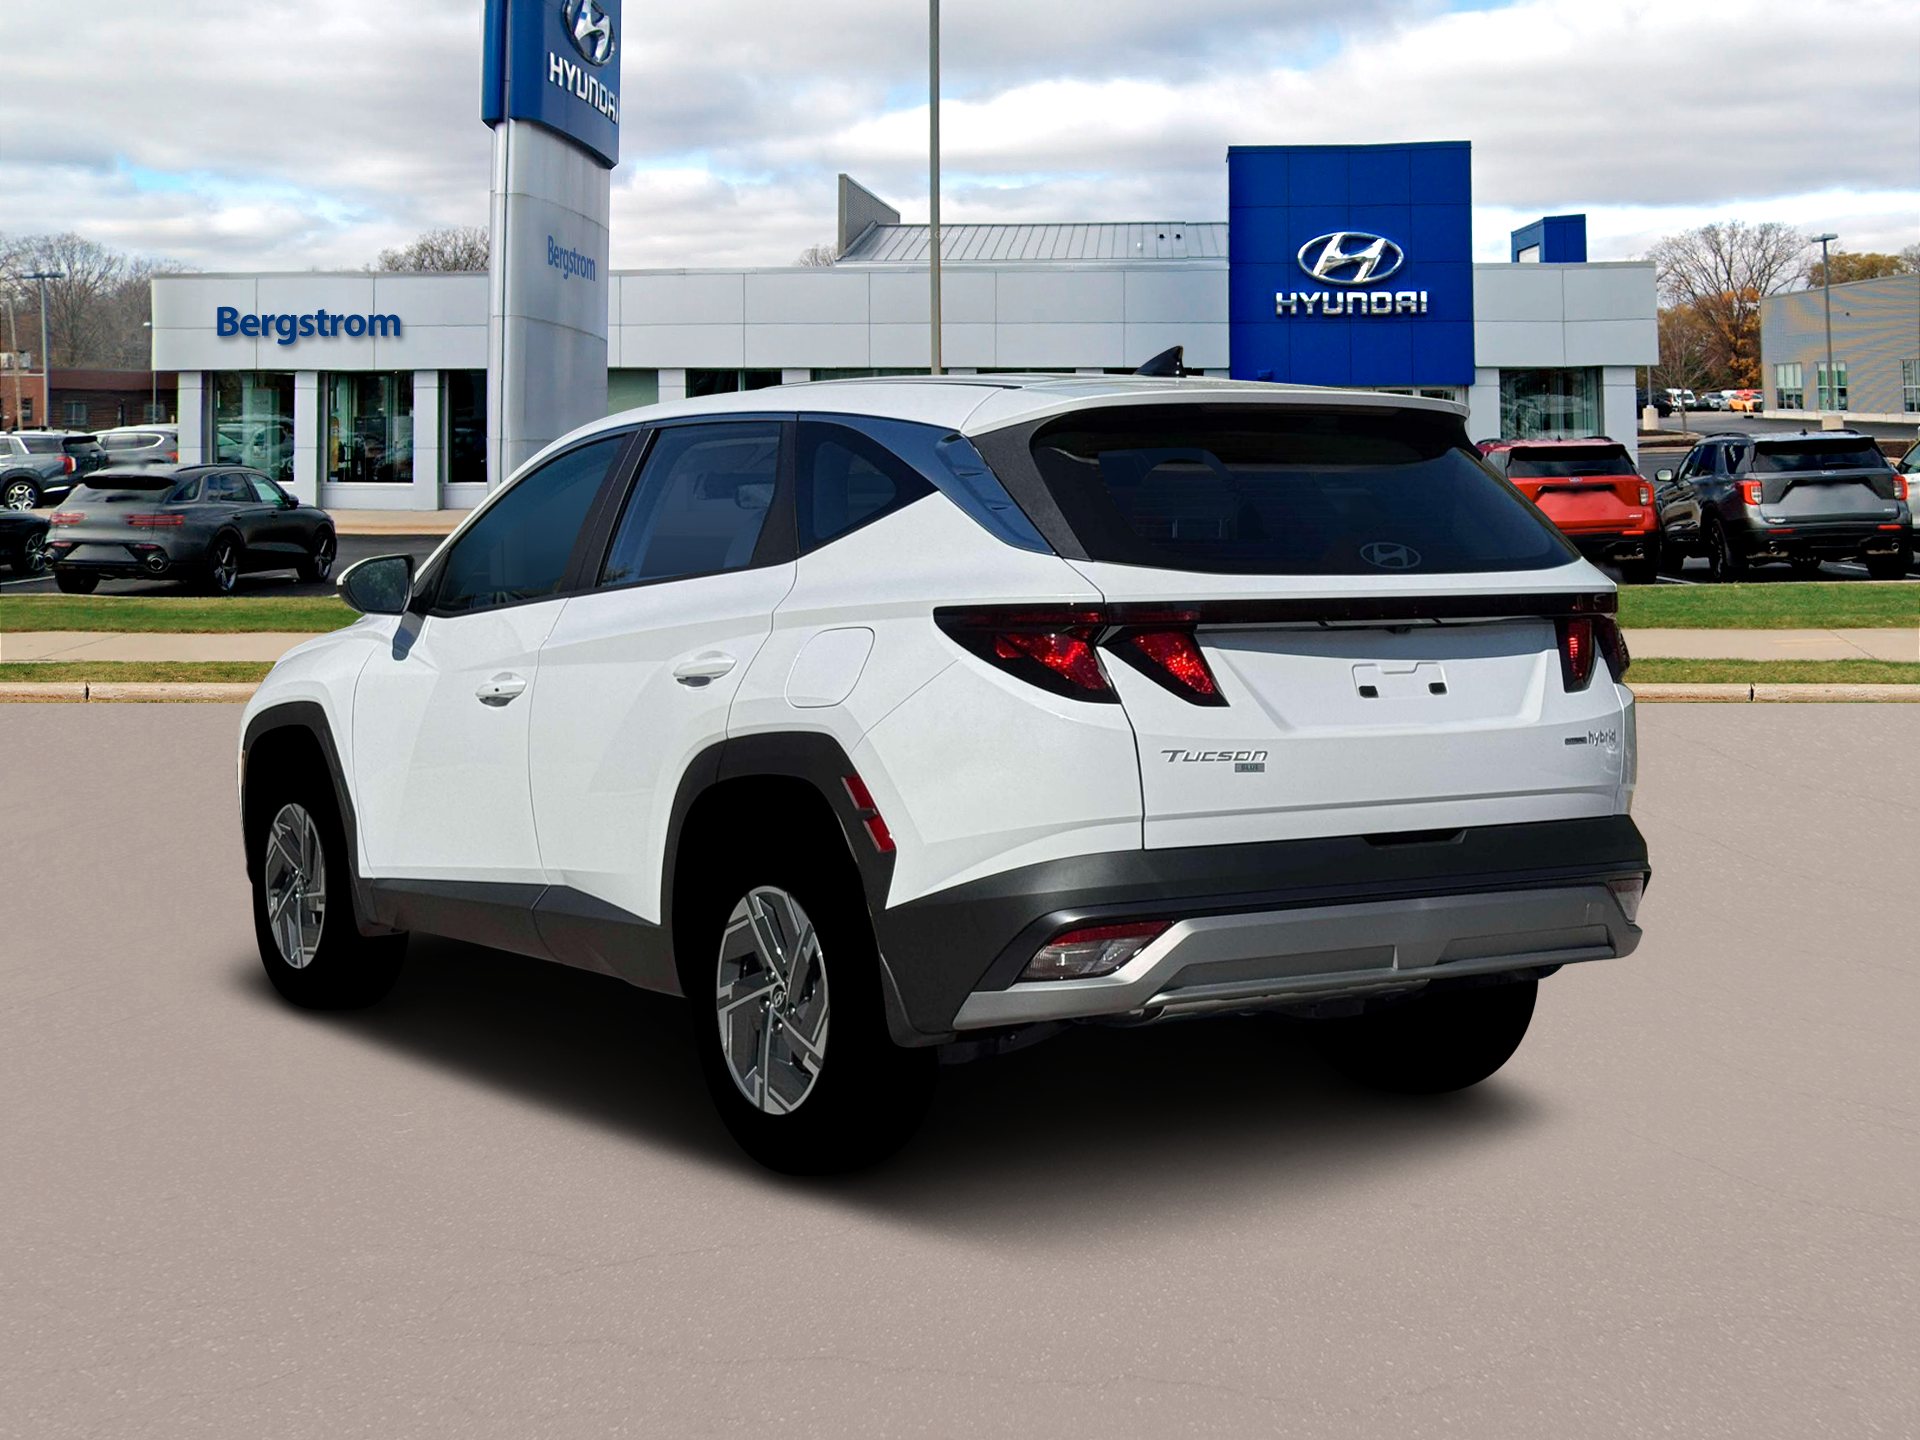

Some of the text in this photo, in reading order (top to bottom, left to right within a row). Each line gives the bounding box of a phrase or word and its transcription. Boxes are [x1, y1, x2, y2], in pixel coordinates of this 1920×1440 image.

[548, 51, 619, 123] HYUNDAI
[547, 235, 596, 282] Bergstrom
[1275, 290, 1428, 316] HYUNDAI
[216, 306, 402, 345] Bergstrom
[1588, 728, 1616, 747] hybrid
